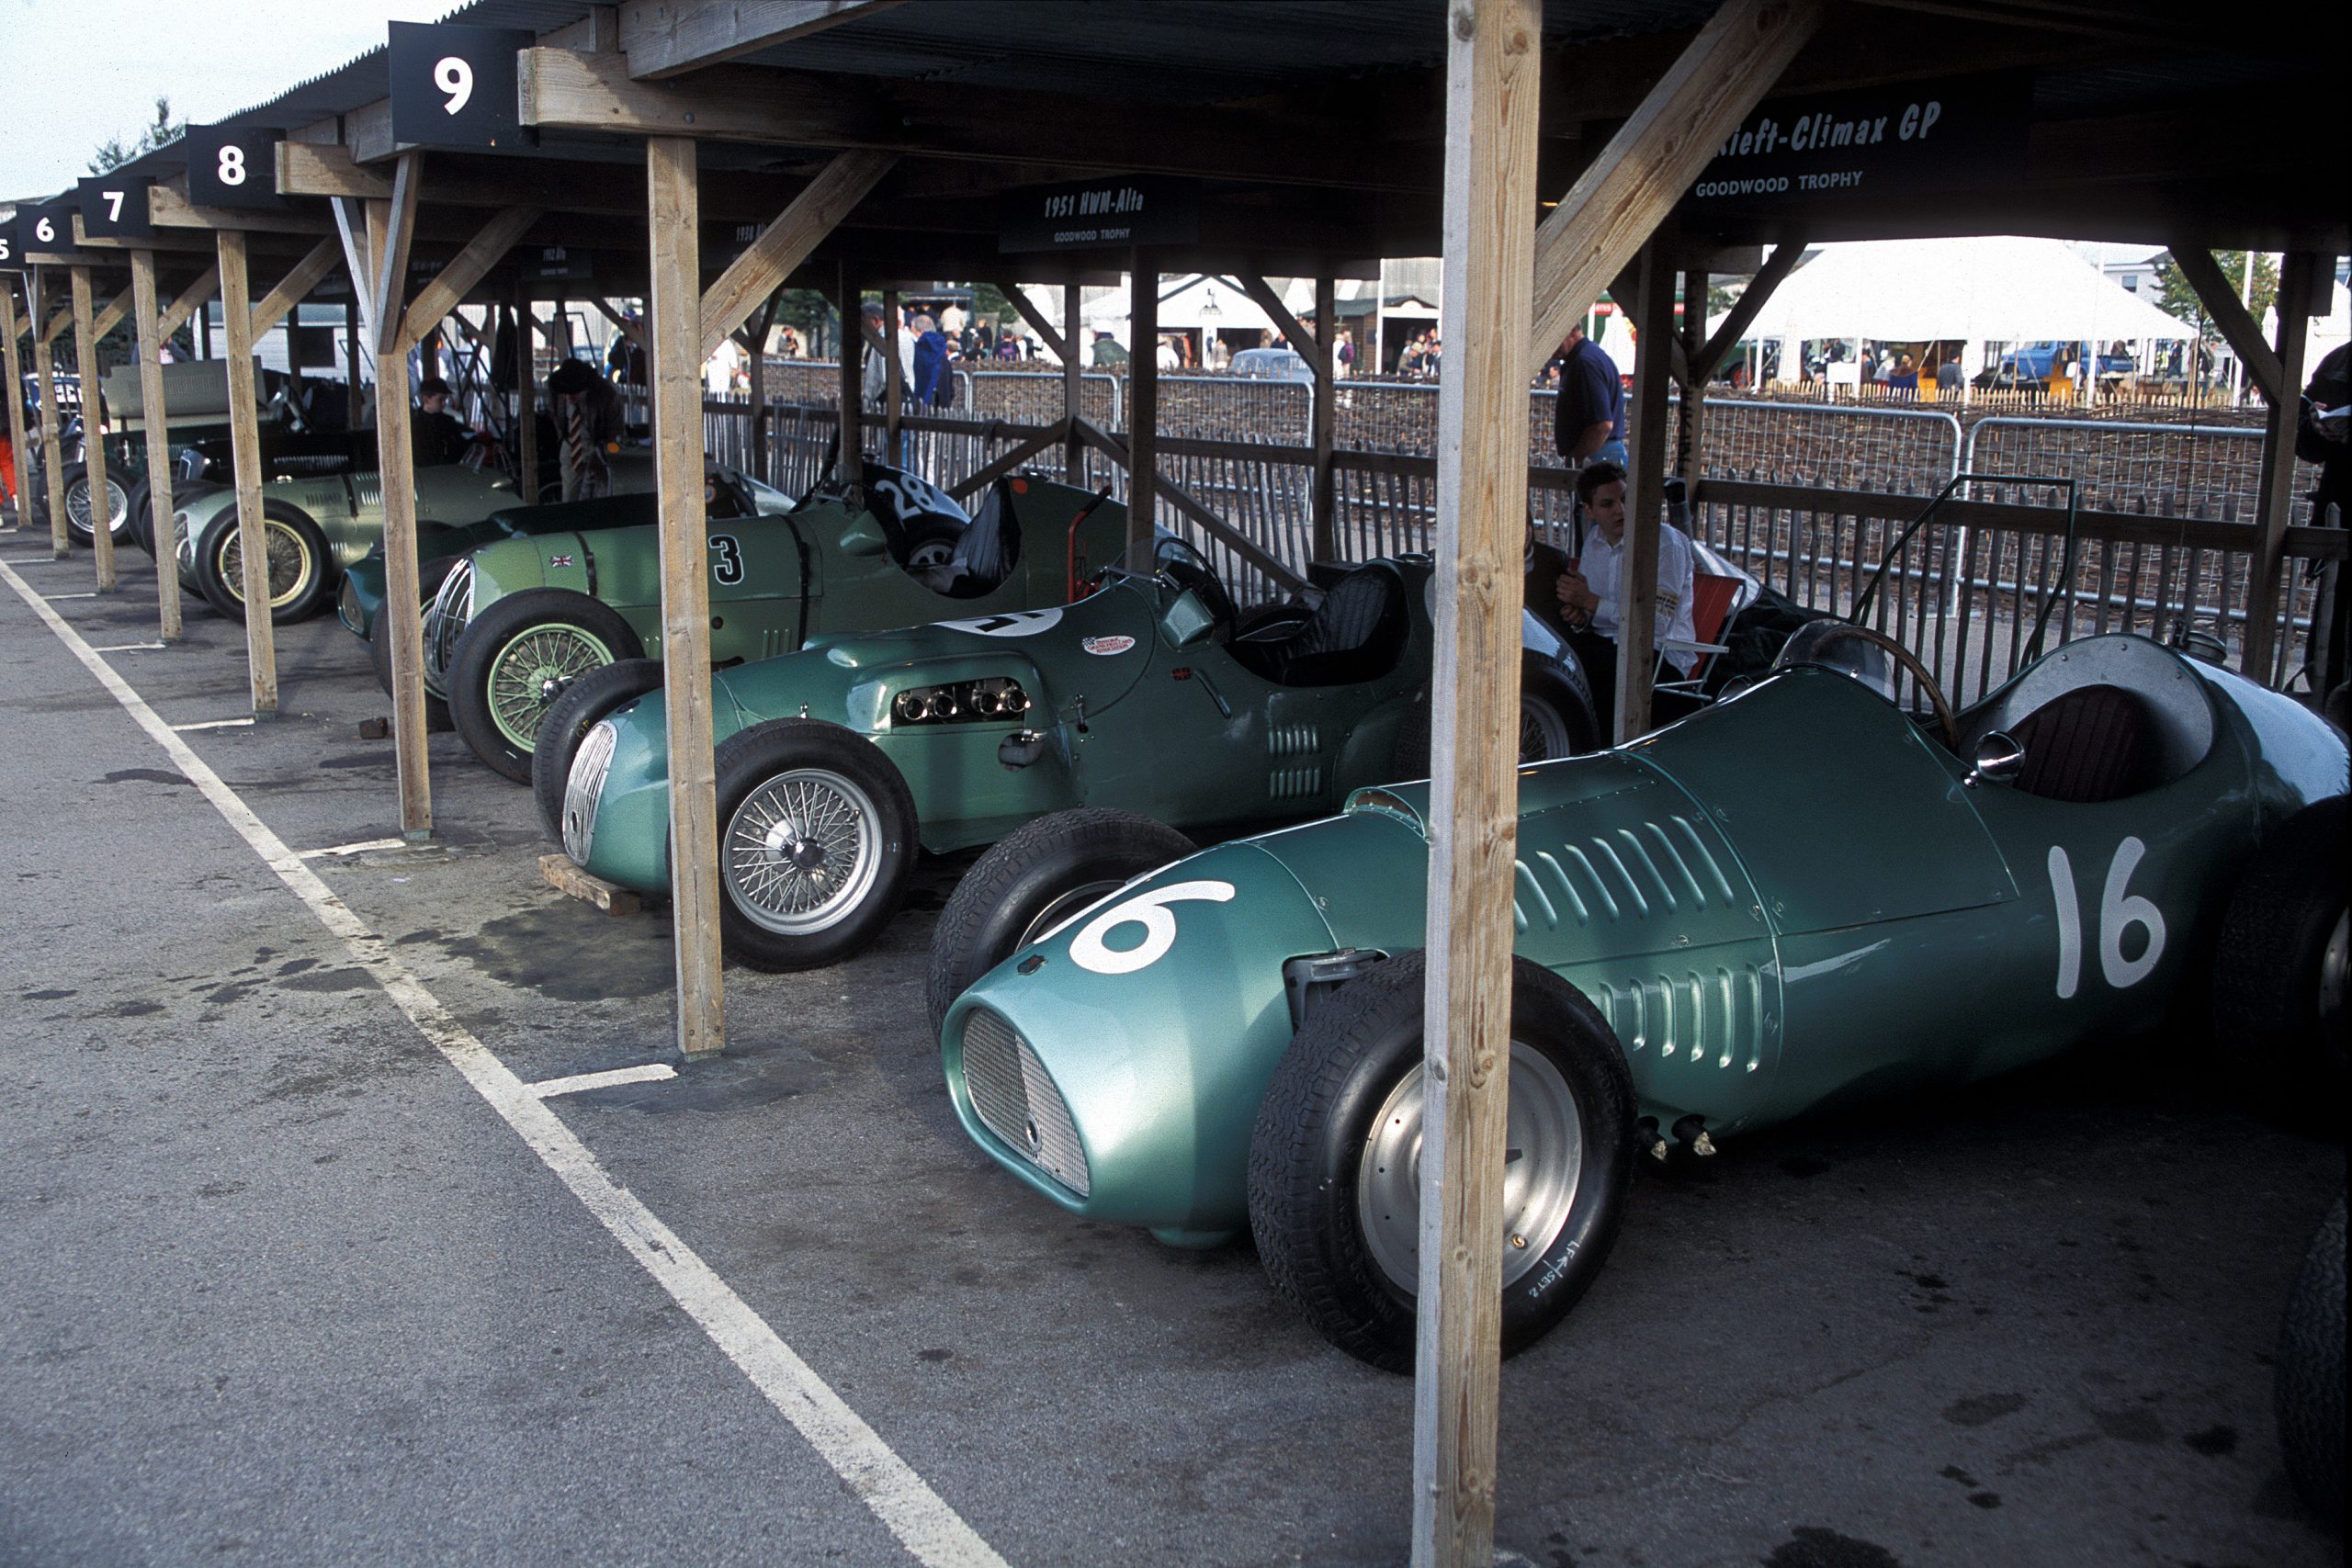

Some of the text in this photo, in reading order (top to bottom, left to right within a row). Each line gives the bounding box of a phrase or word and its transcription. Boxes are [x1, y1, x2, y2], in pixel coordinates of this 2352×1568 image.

[434, 56, 474, 116] 9
[1898, 101, 1941, 141] GP
[218, 144, 246, 186] 8
[1046, 186, 1144, 217] 1951 HWM-Alta
[1695, 171, 1863, 197] GOODWOOD TROPHY
[102, 191, 124, 222] 7
[36, 217, 55, 243] 6
[1054, 228, 1131, 243] GOODWOOD TROPHY
[875, 474, 938, 520] 28
[708, 534, 744, 585] 3
[2048, 836, 2165, 998] 16
[1566, 1240, 1580, 1258] LF
